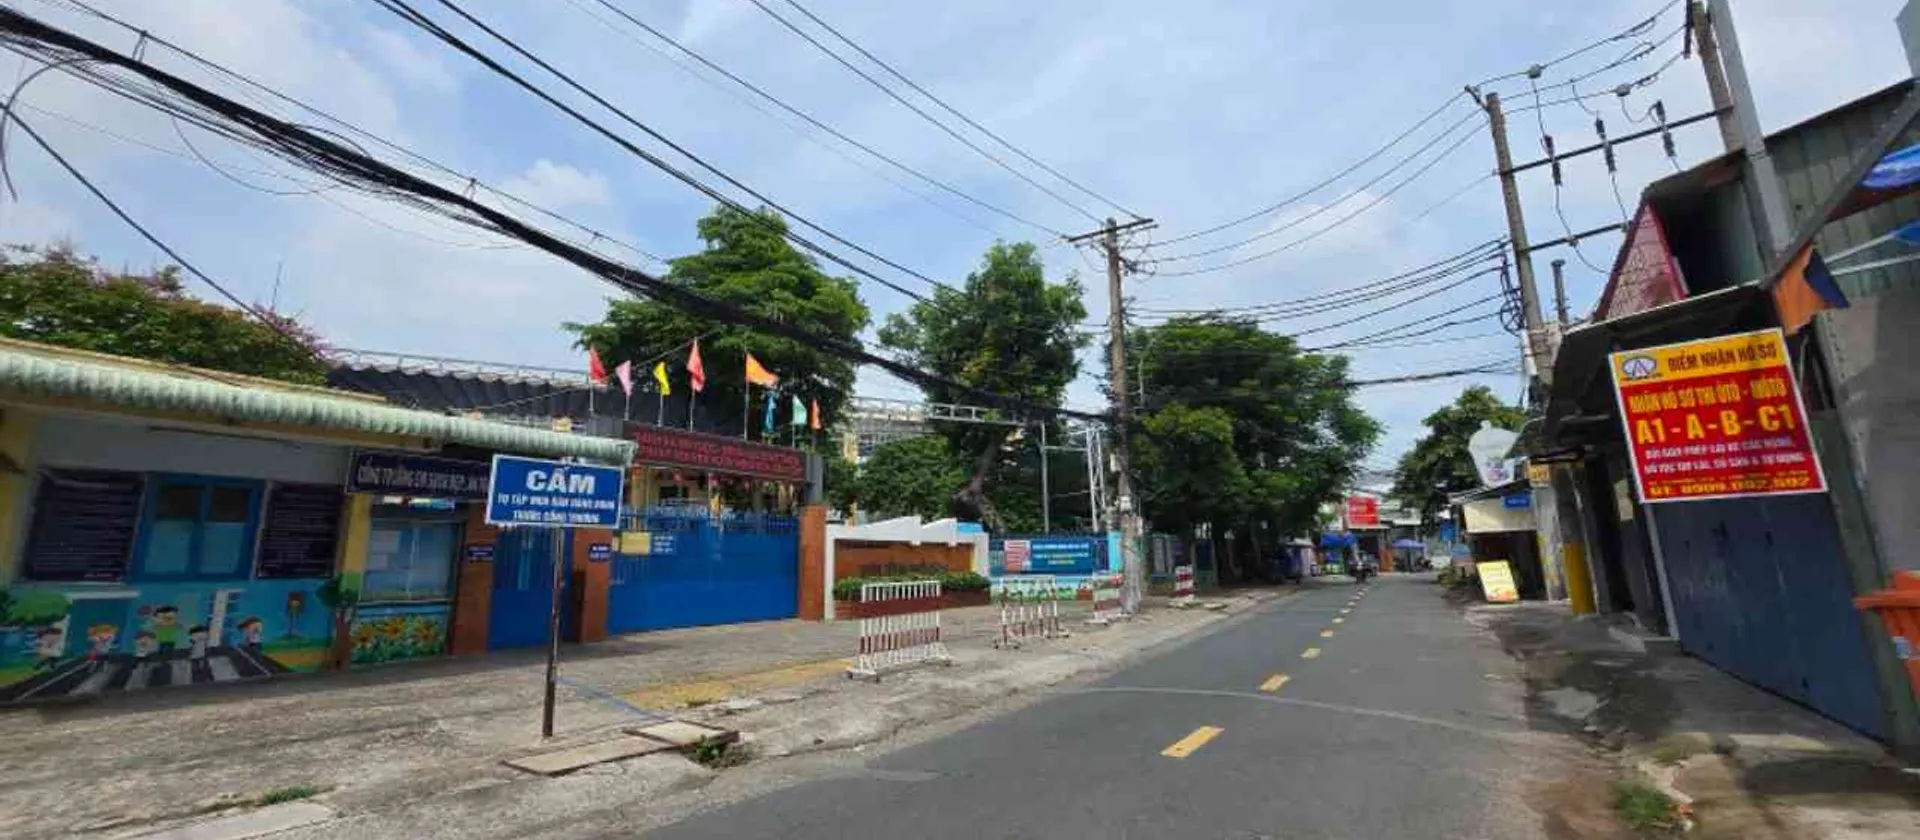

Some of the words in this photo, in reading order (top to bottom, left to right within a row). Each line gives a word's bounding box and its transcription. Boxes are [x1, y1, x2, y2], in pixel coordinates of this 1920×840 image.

[1668, 350, 1699, 372] ĐIỂM
[1700, 347, 1736, 368] NHẬN
[1756, 341, 1777, 360] SƠ
[1636, 417, 1666, 445] A1
[1686, 413, 1705, 440] A
[1719, 409, 1742, 436] B
[1757, 404, 1796, 433] C1
[525, 466, 596, 495] CẤM
